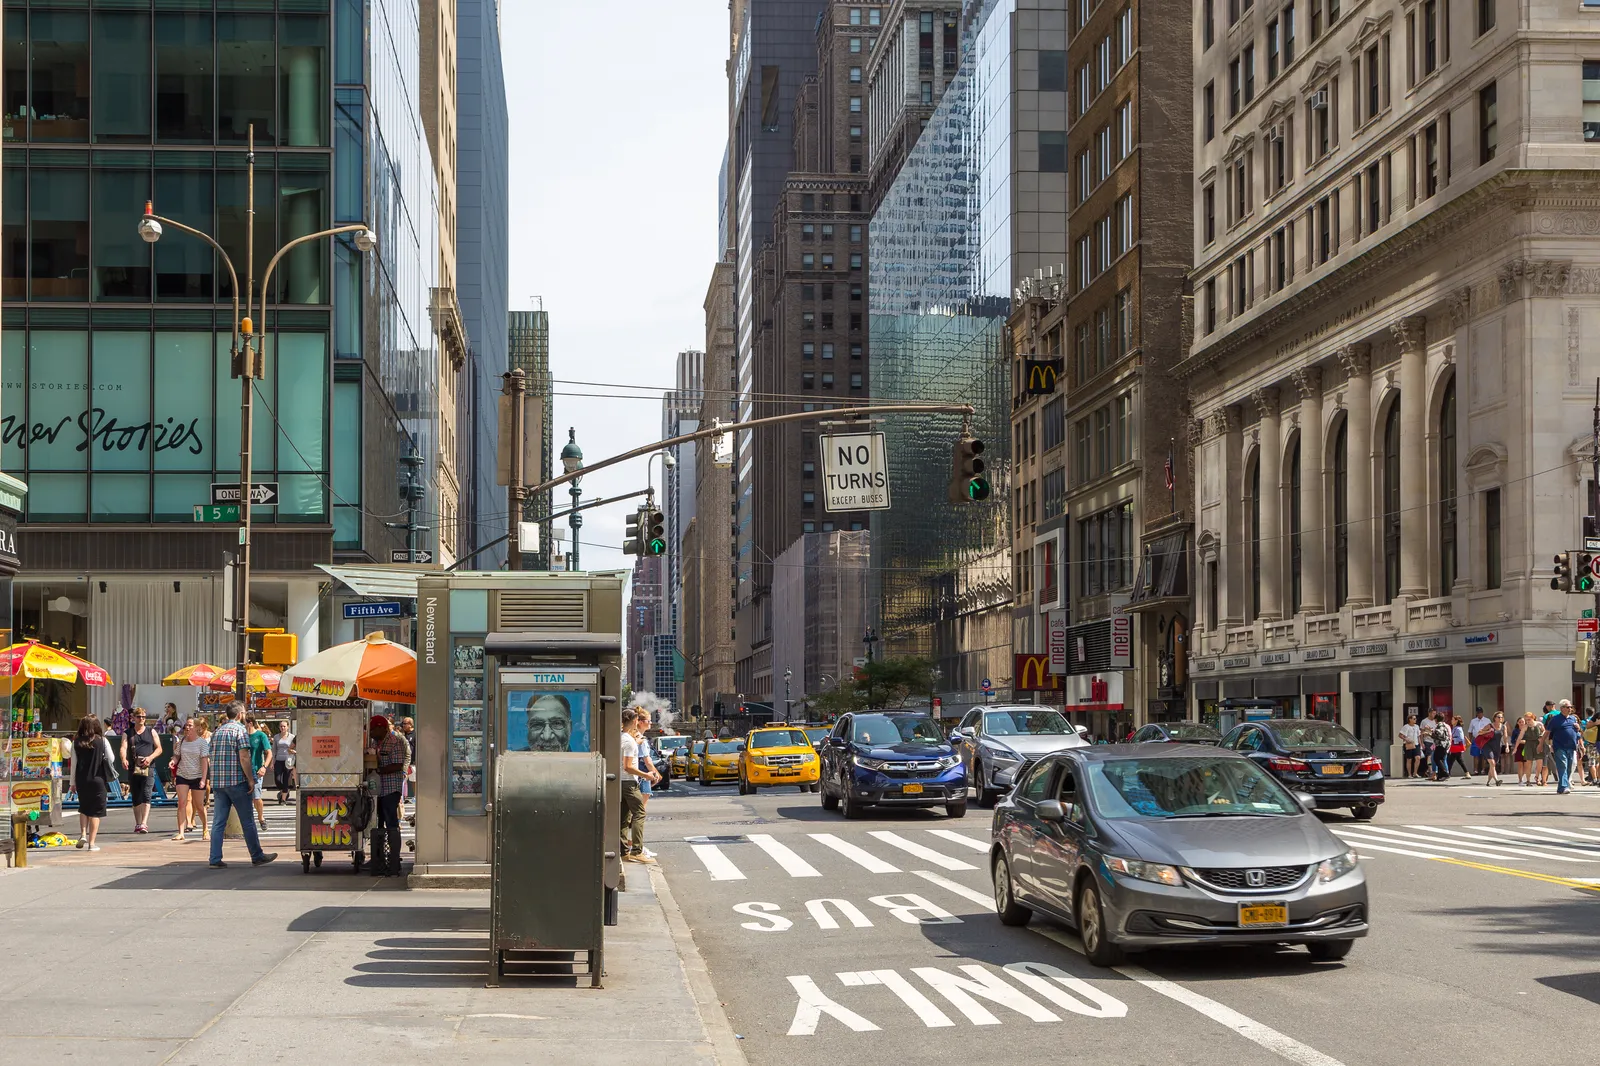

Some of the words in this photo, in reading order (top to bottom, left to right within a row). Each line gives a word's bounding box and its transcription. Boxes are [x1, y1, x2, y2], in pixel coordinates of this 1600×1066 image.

[1335, 296, 1377, 327] COMPANY
[76, 408, 203, 455] Stories
[838, 445, 869, 466] NO
[827, 472, 885, 490] TURNS
[221, 490, 241, 499] ONE
[832, 495, 857, 505] EXCEPT
[861, 494, 884, 504] BUSES
[212, 507, 221, 520] 5
[350, 607, 376, 616] Fifth
[376, 606, 394, 615] Ave
[426, 597, 437, 664] Newsstand
[1112, 618, 1129, 656] metro
[1050, 630, 1065, 665] metro
[1318, 649, 1330, 658] PIZZA
[1408, 640, 1415, 649] GO
[1416, 639, 1423, 649] NY
[1424, 637, 1440, 648] TOURS
[533, 674, 565, 683] TITAN
[306, 795, 347, 817] NUTS
[322, 808, 339, 829] 4
[311, 823, 352, 845] NUTS
[732, 893, 965, 932] BUS
[786, 962, 1129, 1036] ONLY
